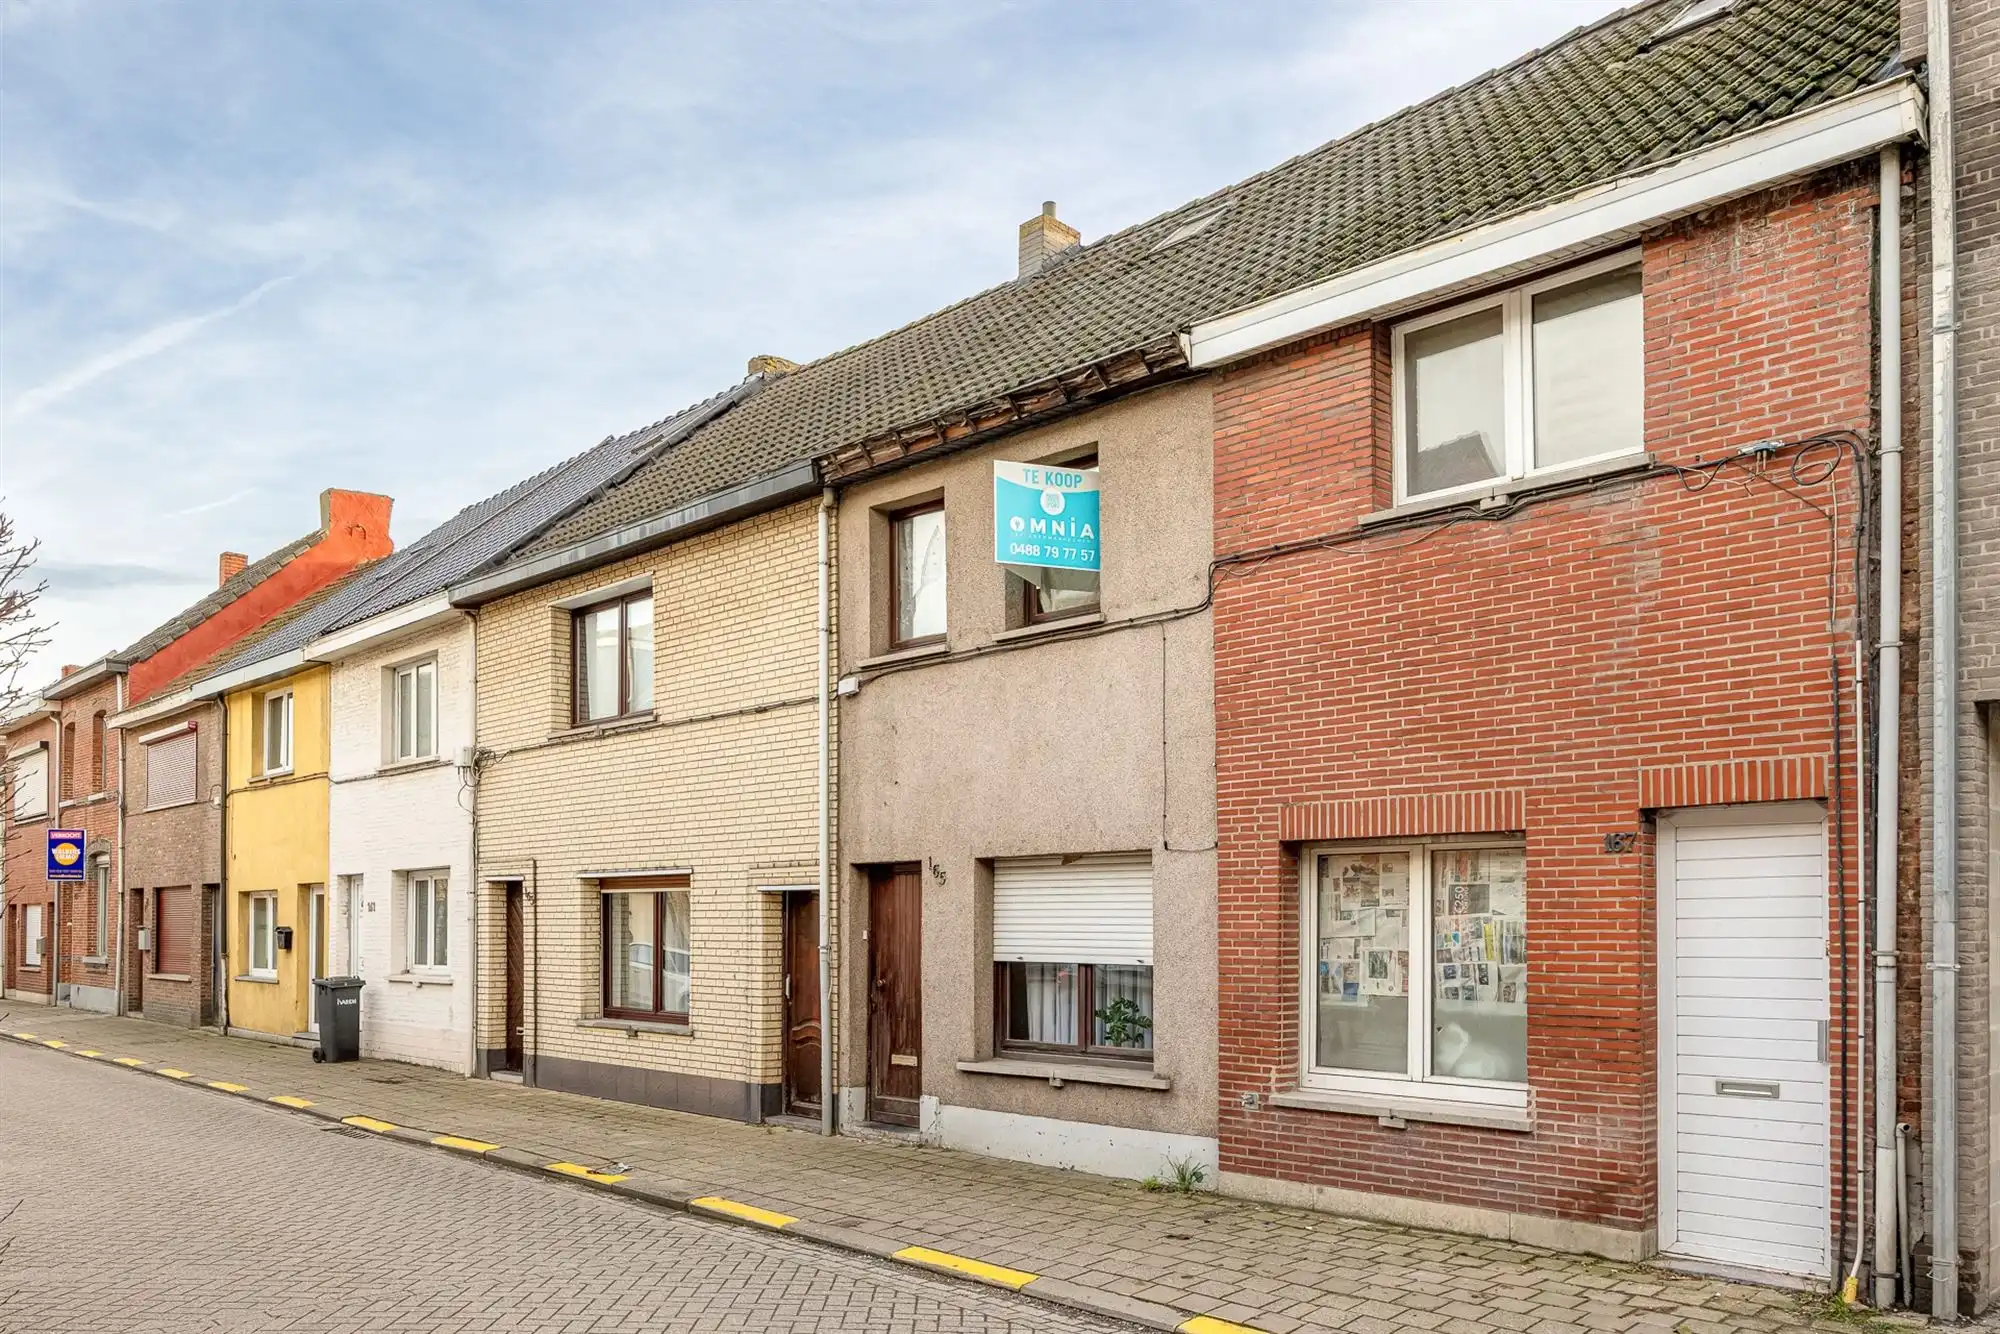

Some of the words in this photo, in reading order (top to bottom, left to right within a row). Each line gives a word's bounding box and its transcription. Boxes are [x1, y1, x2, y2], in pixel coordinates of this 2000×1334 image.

[1022, 468, 1039, 484] TE
[1045, 471, 1083, 488] KOOP
[1010, 543, 1040, 557] 0488
[1044, 545, 1059, 558] 79
[1063, 547, 1077, 560] 77
[1080, 550, 1095, 561] 57
[1603, 832, 1637, 853] 167
[929, 856, 946, 886] 165
